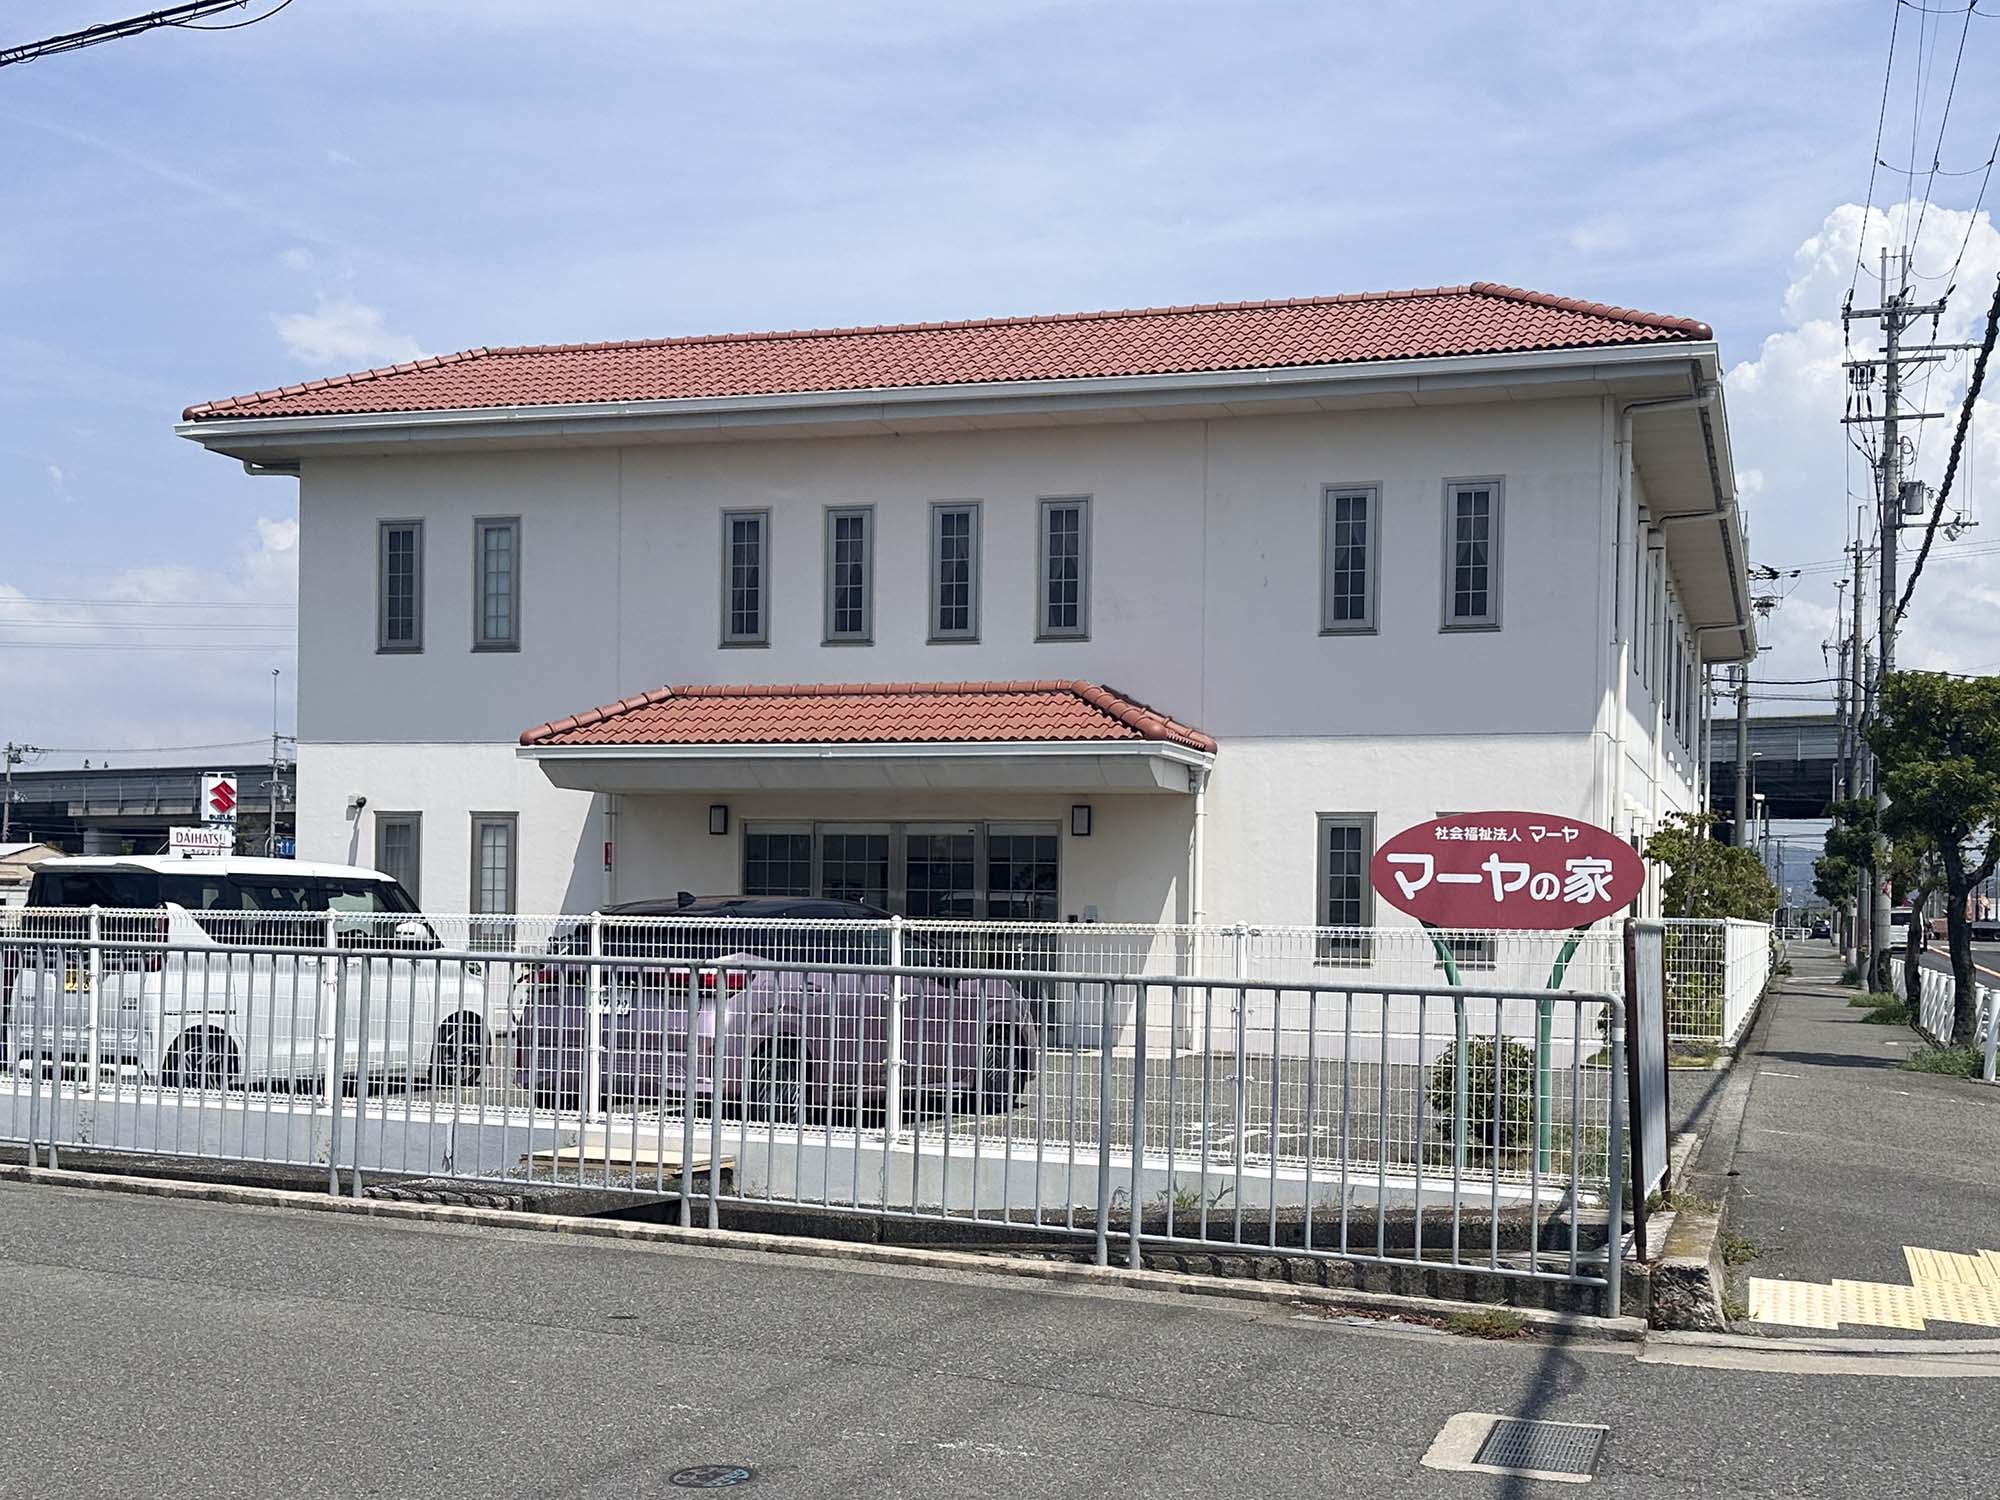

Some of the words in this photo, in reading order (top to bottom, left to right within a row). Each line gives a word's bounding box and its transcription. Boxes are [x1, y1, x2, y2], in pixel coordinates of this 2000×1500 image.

[176, 831, 226, 845] DAIHATSU
[1435, 826, 1522, 842] 社会福祉法人
[1528, 825, 1579, 843] マーヤ
[1386, 852, 1614, 904] マーヤの家
